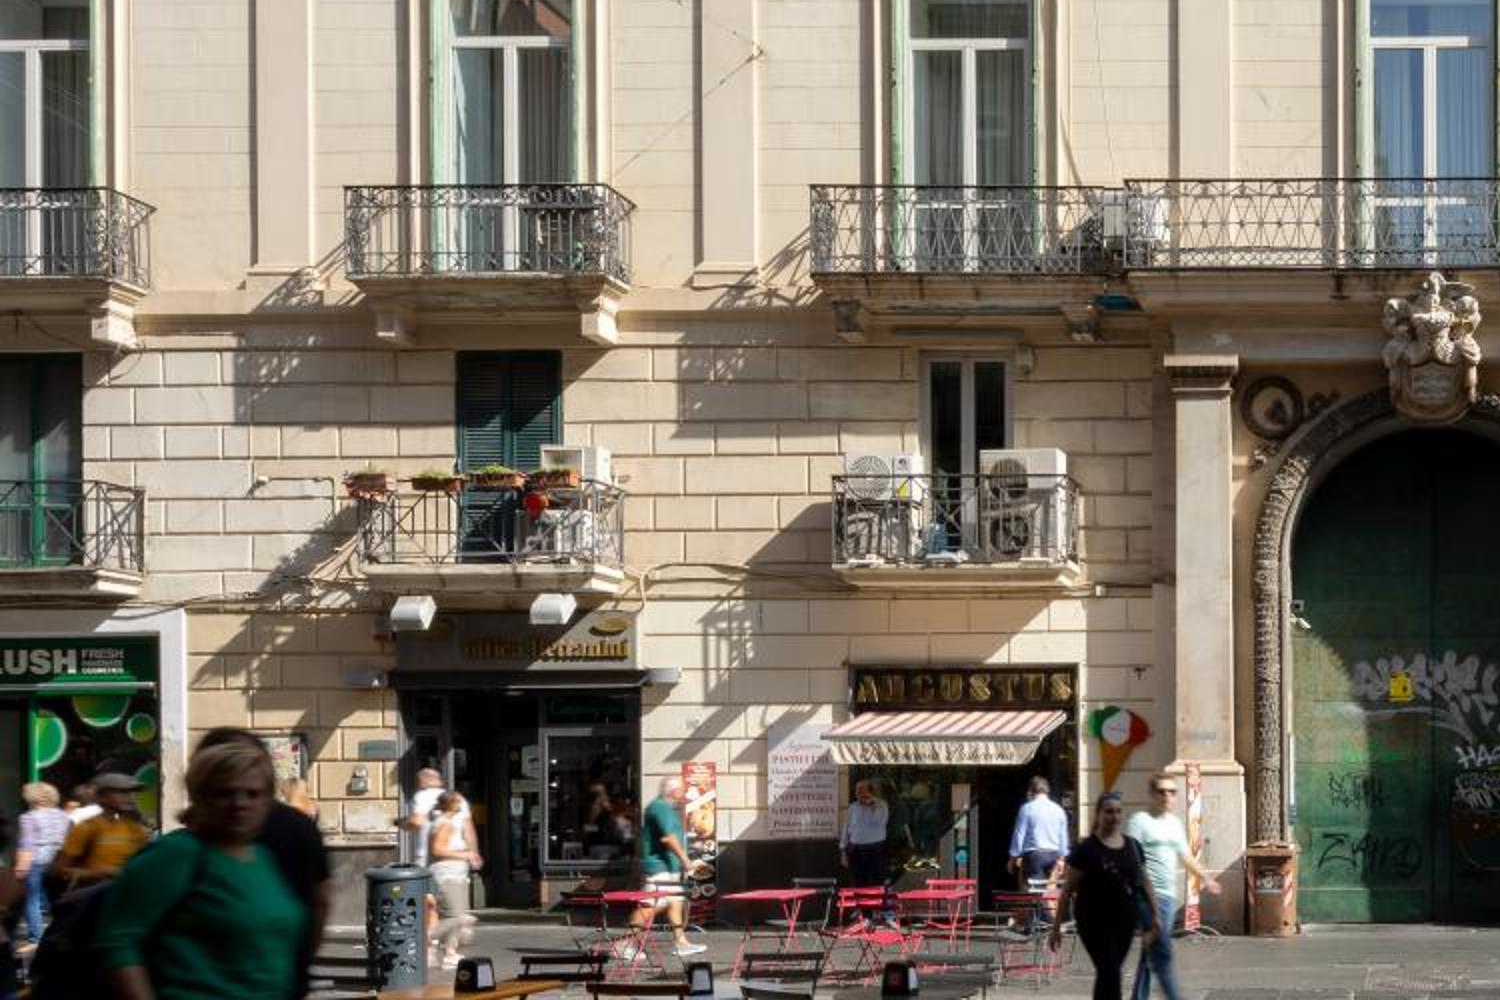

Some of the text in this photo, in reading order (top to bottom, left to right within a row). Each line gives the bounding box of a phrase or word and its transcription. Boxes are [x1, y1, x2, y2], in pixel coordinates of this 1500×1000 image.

[0, 648, 77, 675] USH
[81, 648, 125, 659] FRESH
[858, 674, 1073, 703] AUGUSTUS
